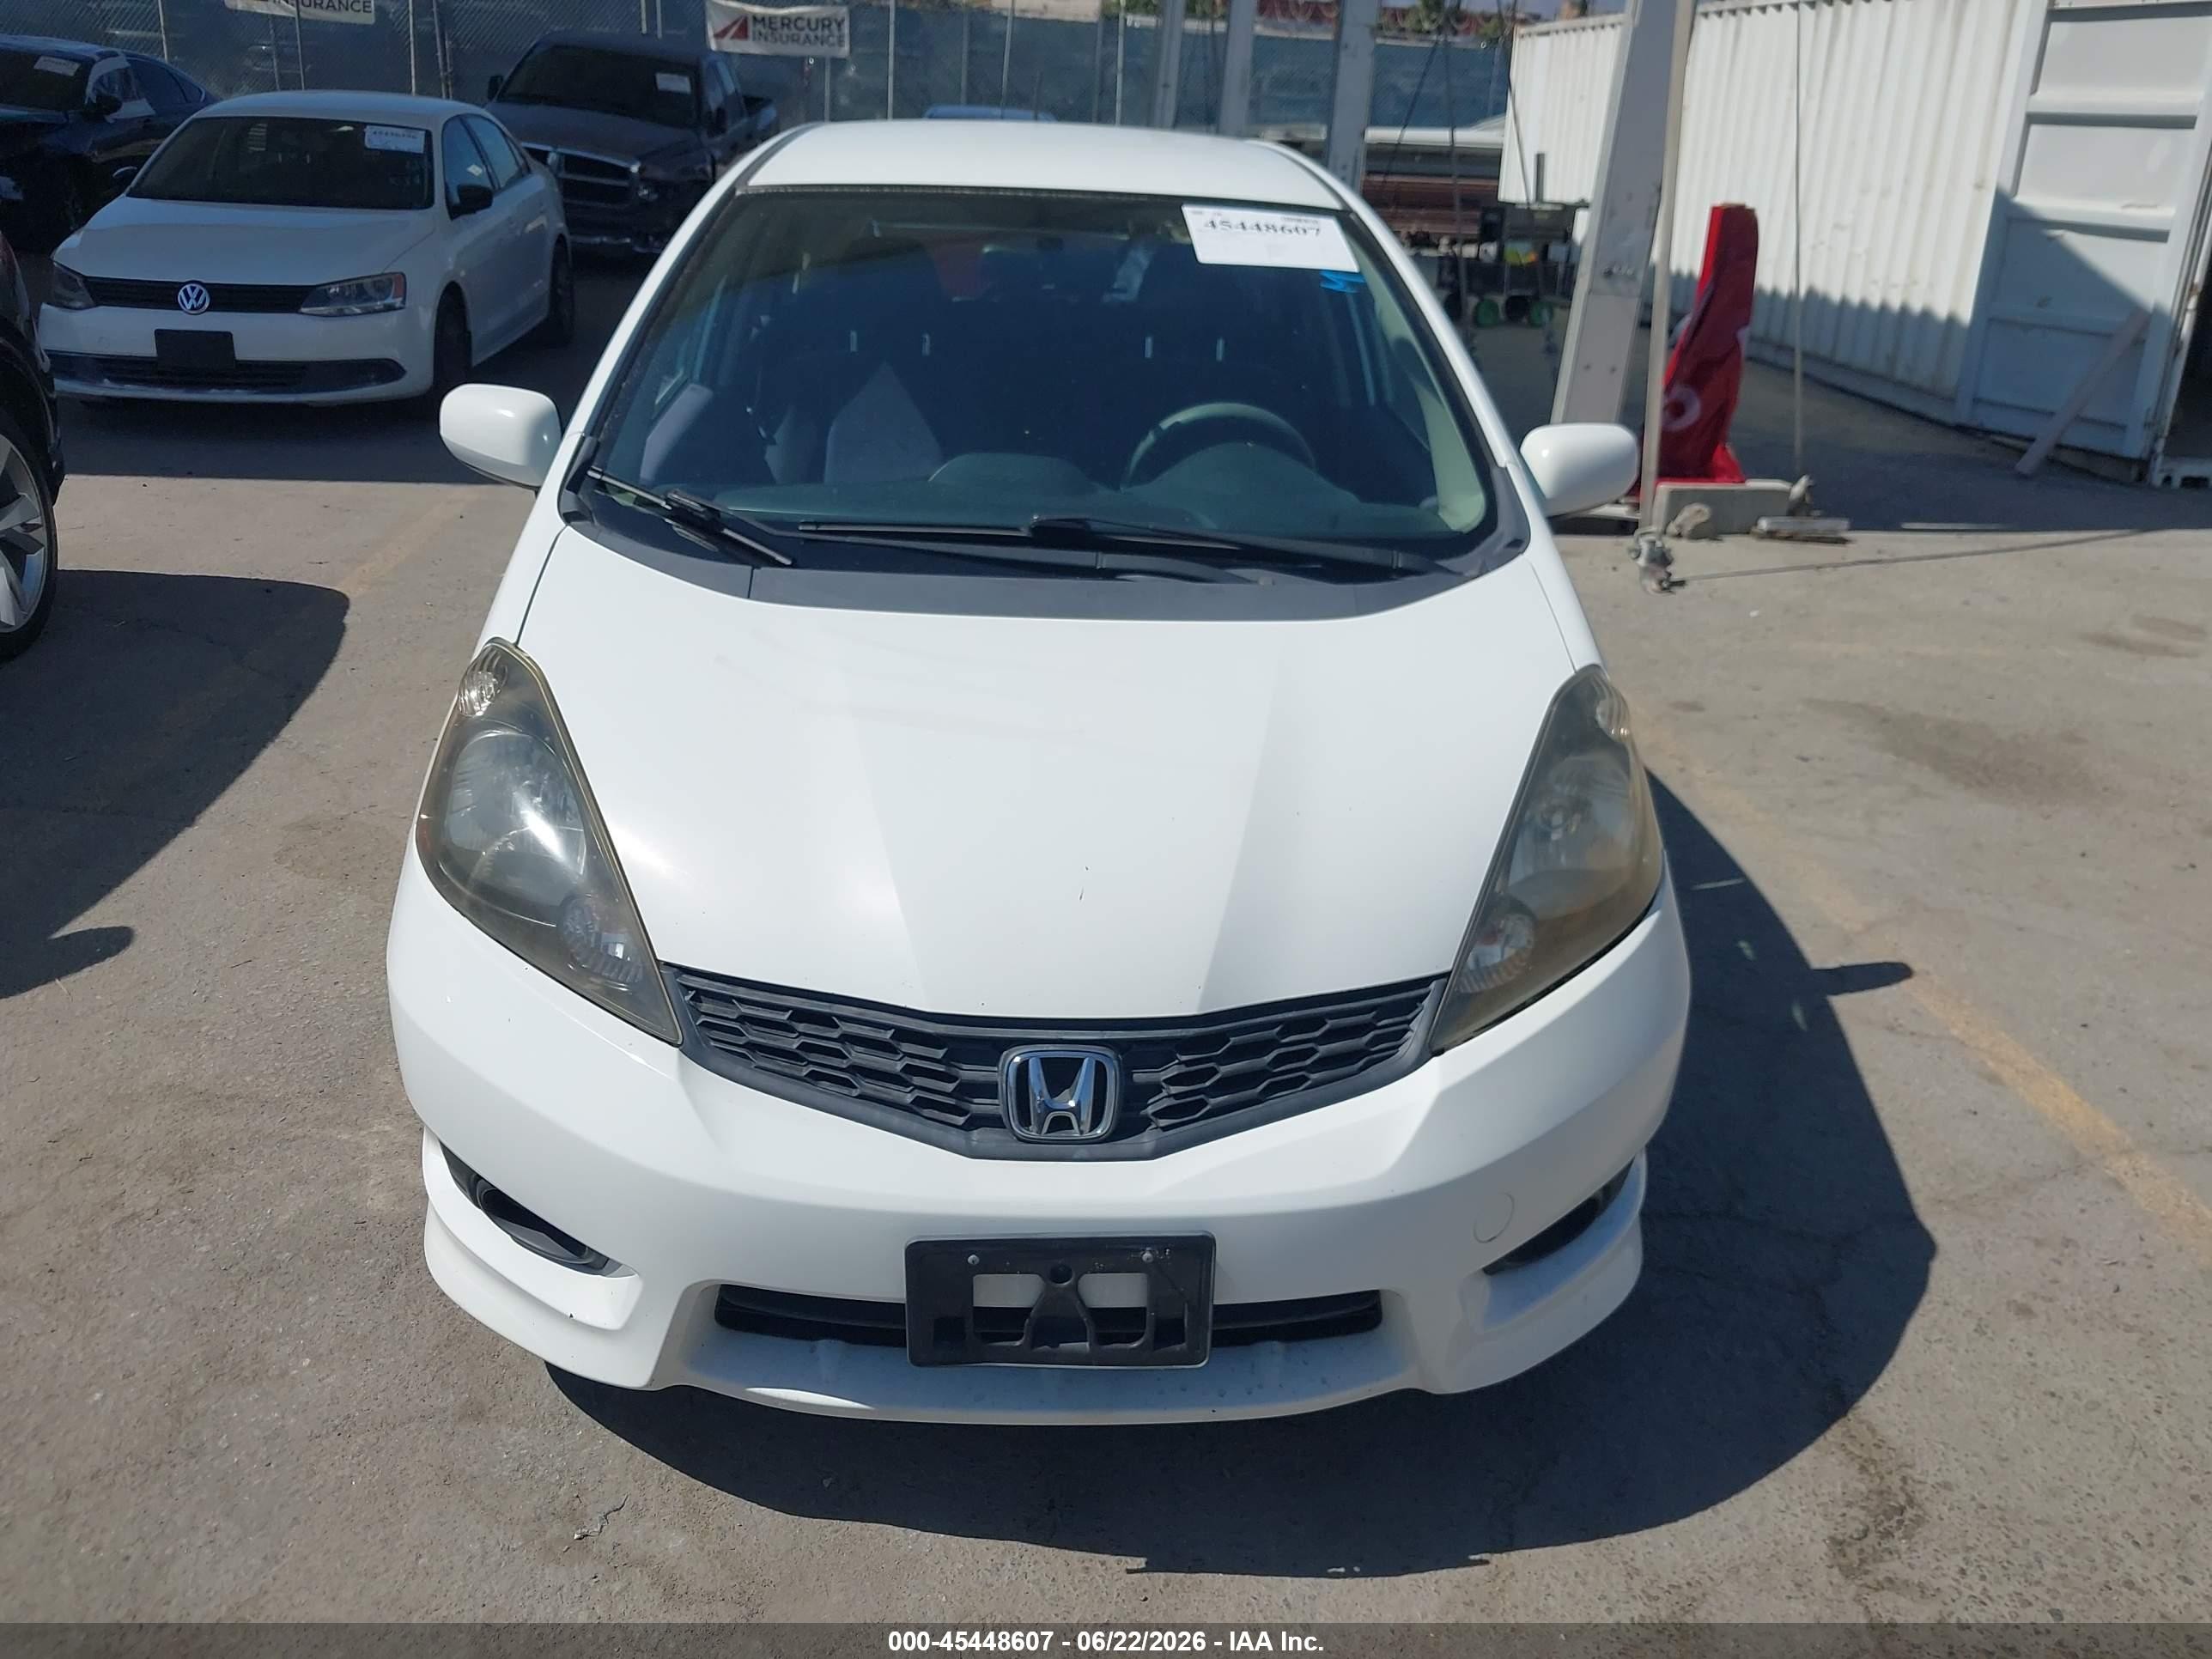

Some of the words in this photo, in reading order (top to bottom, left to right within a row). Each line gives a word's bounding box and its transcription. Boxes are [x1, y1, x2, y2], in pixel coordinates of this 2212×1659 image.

[752, 15, 846, 32] MERCURY
[752, 30, 846, 47] INSURANCE
[1205, 220, 1320, 236] 45448607
